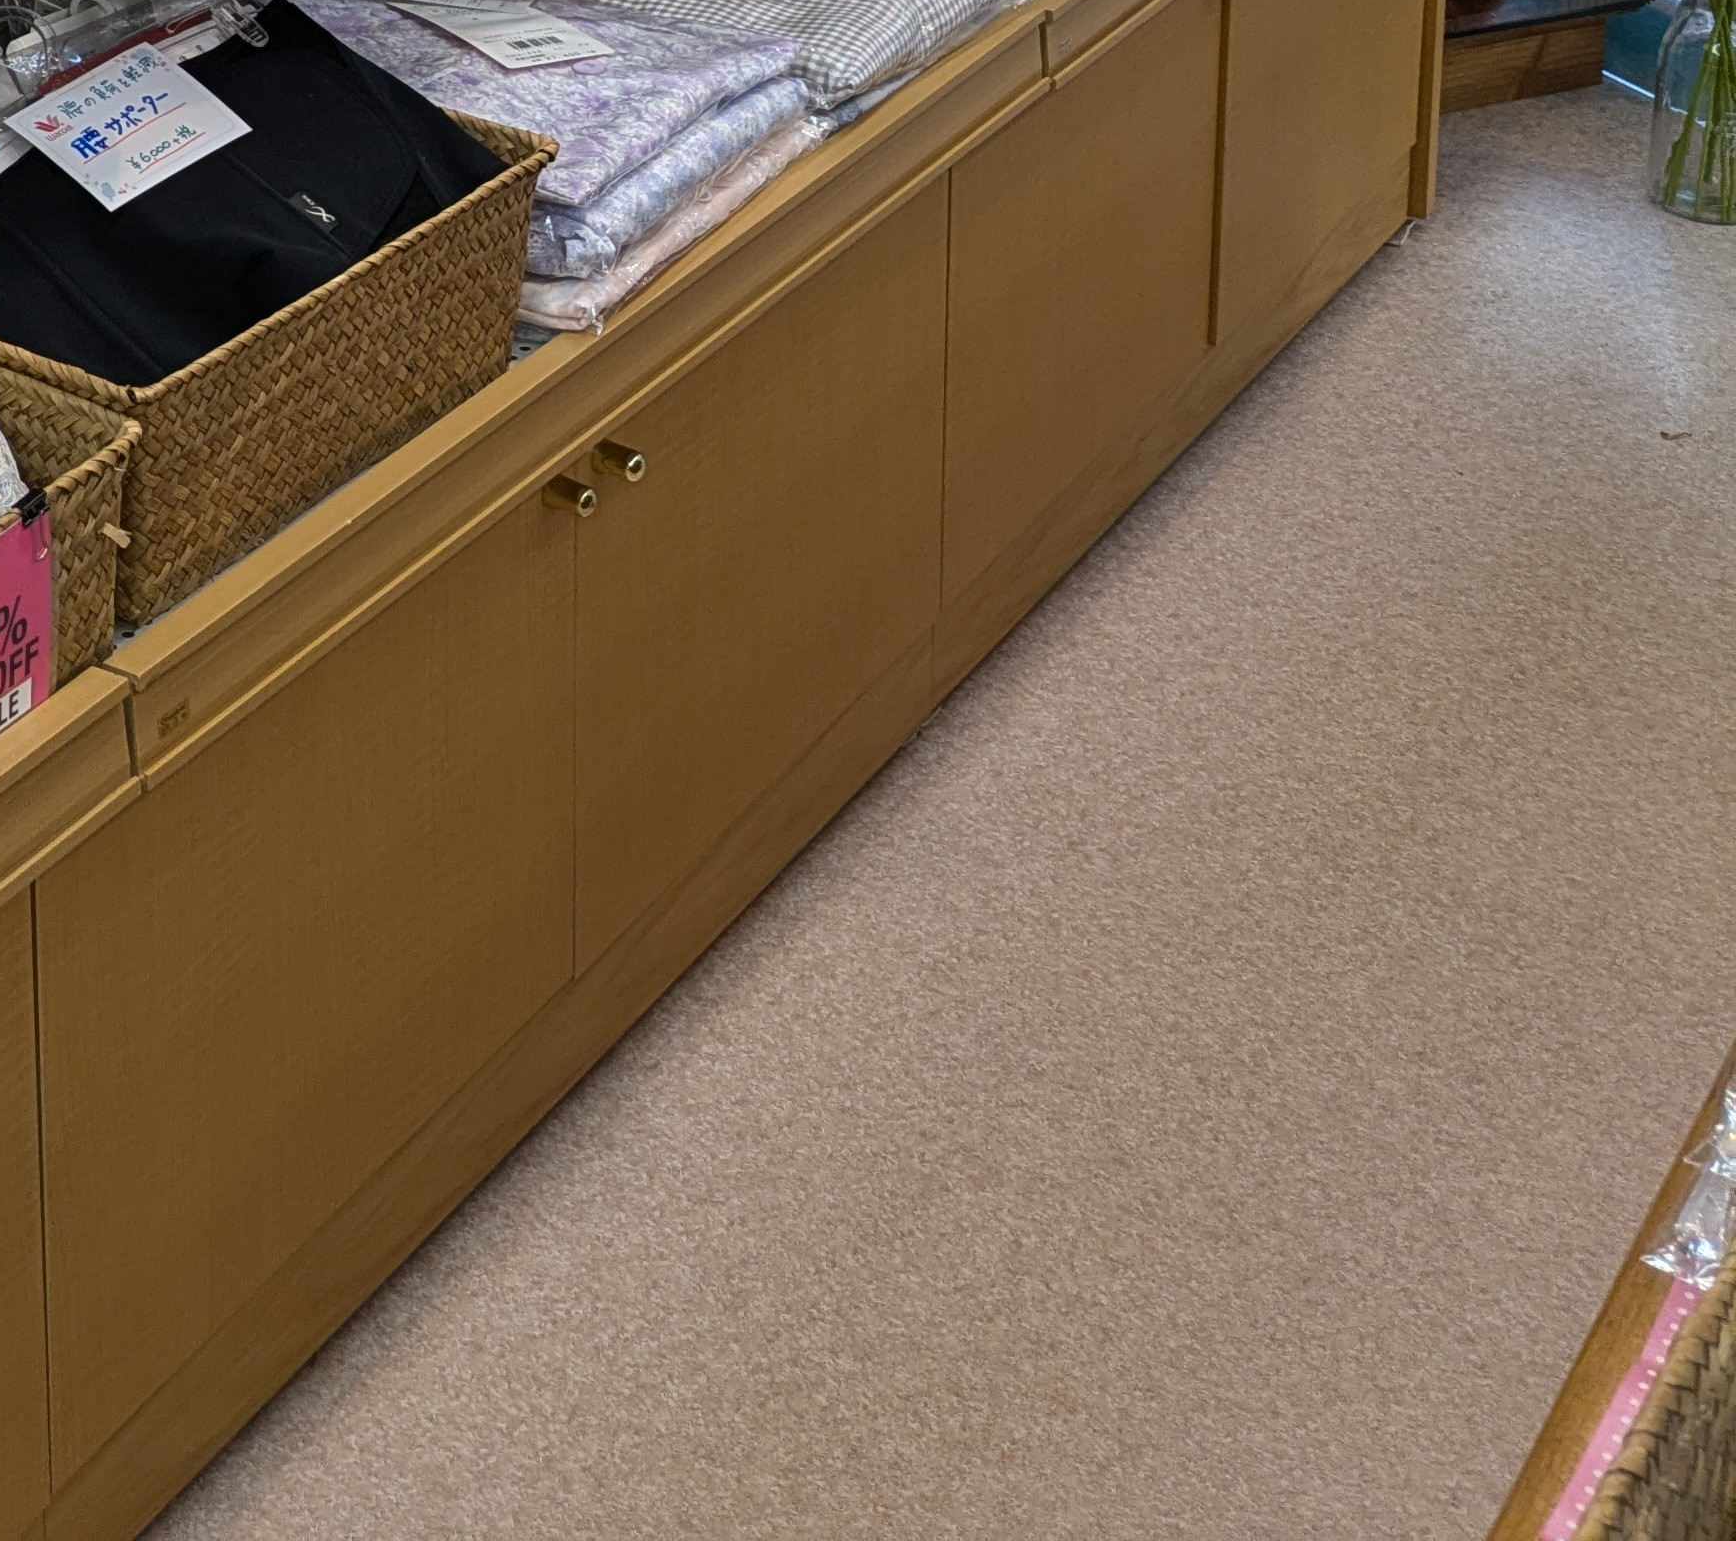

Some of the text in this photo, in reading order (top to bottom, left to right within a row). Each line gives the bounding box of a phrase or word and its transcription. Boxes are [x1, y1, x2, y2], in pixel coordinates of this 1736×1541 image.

[57, 55, 158, 121] 腰の負荷を軽減
[70, 91, 170, 159] 腰サポーター
